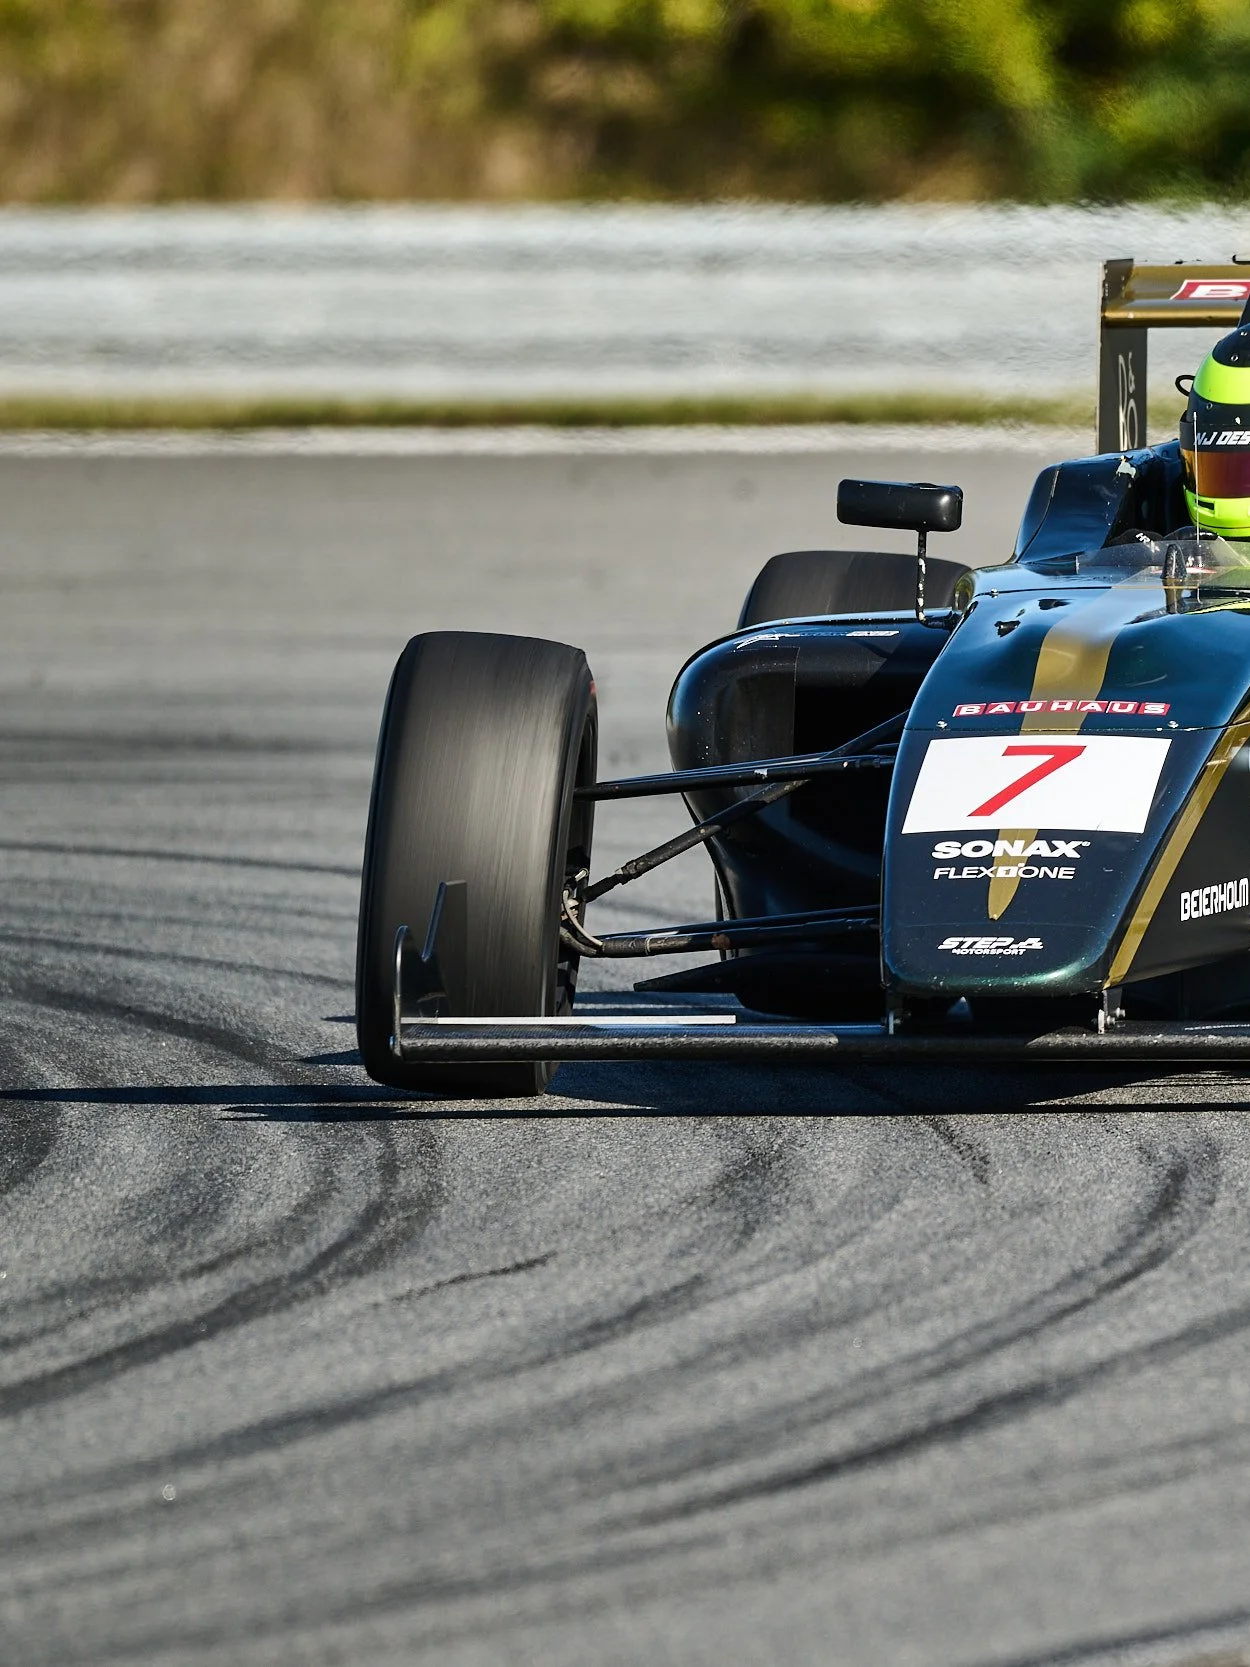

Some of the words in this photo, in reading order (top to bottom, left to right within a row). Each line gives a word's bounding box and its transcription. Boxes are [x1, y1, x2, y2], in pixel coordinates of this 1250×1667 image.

[959, 700, 1165, 716] BAUHAUS
[966, 745, 1087, 817] 7
[1180, 877, 1249, 922] BEIERHOLM
